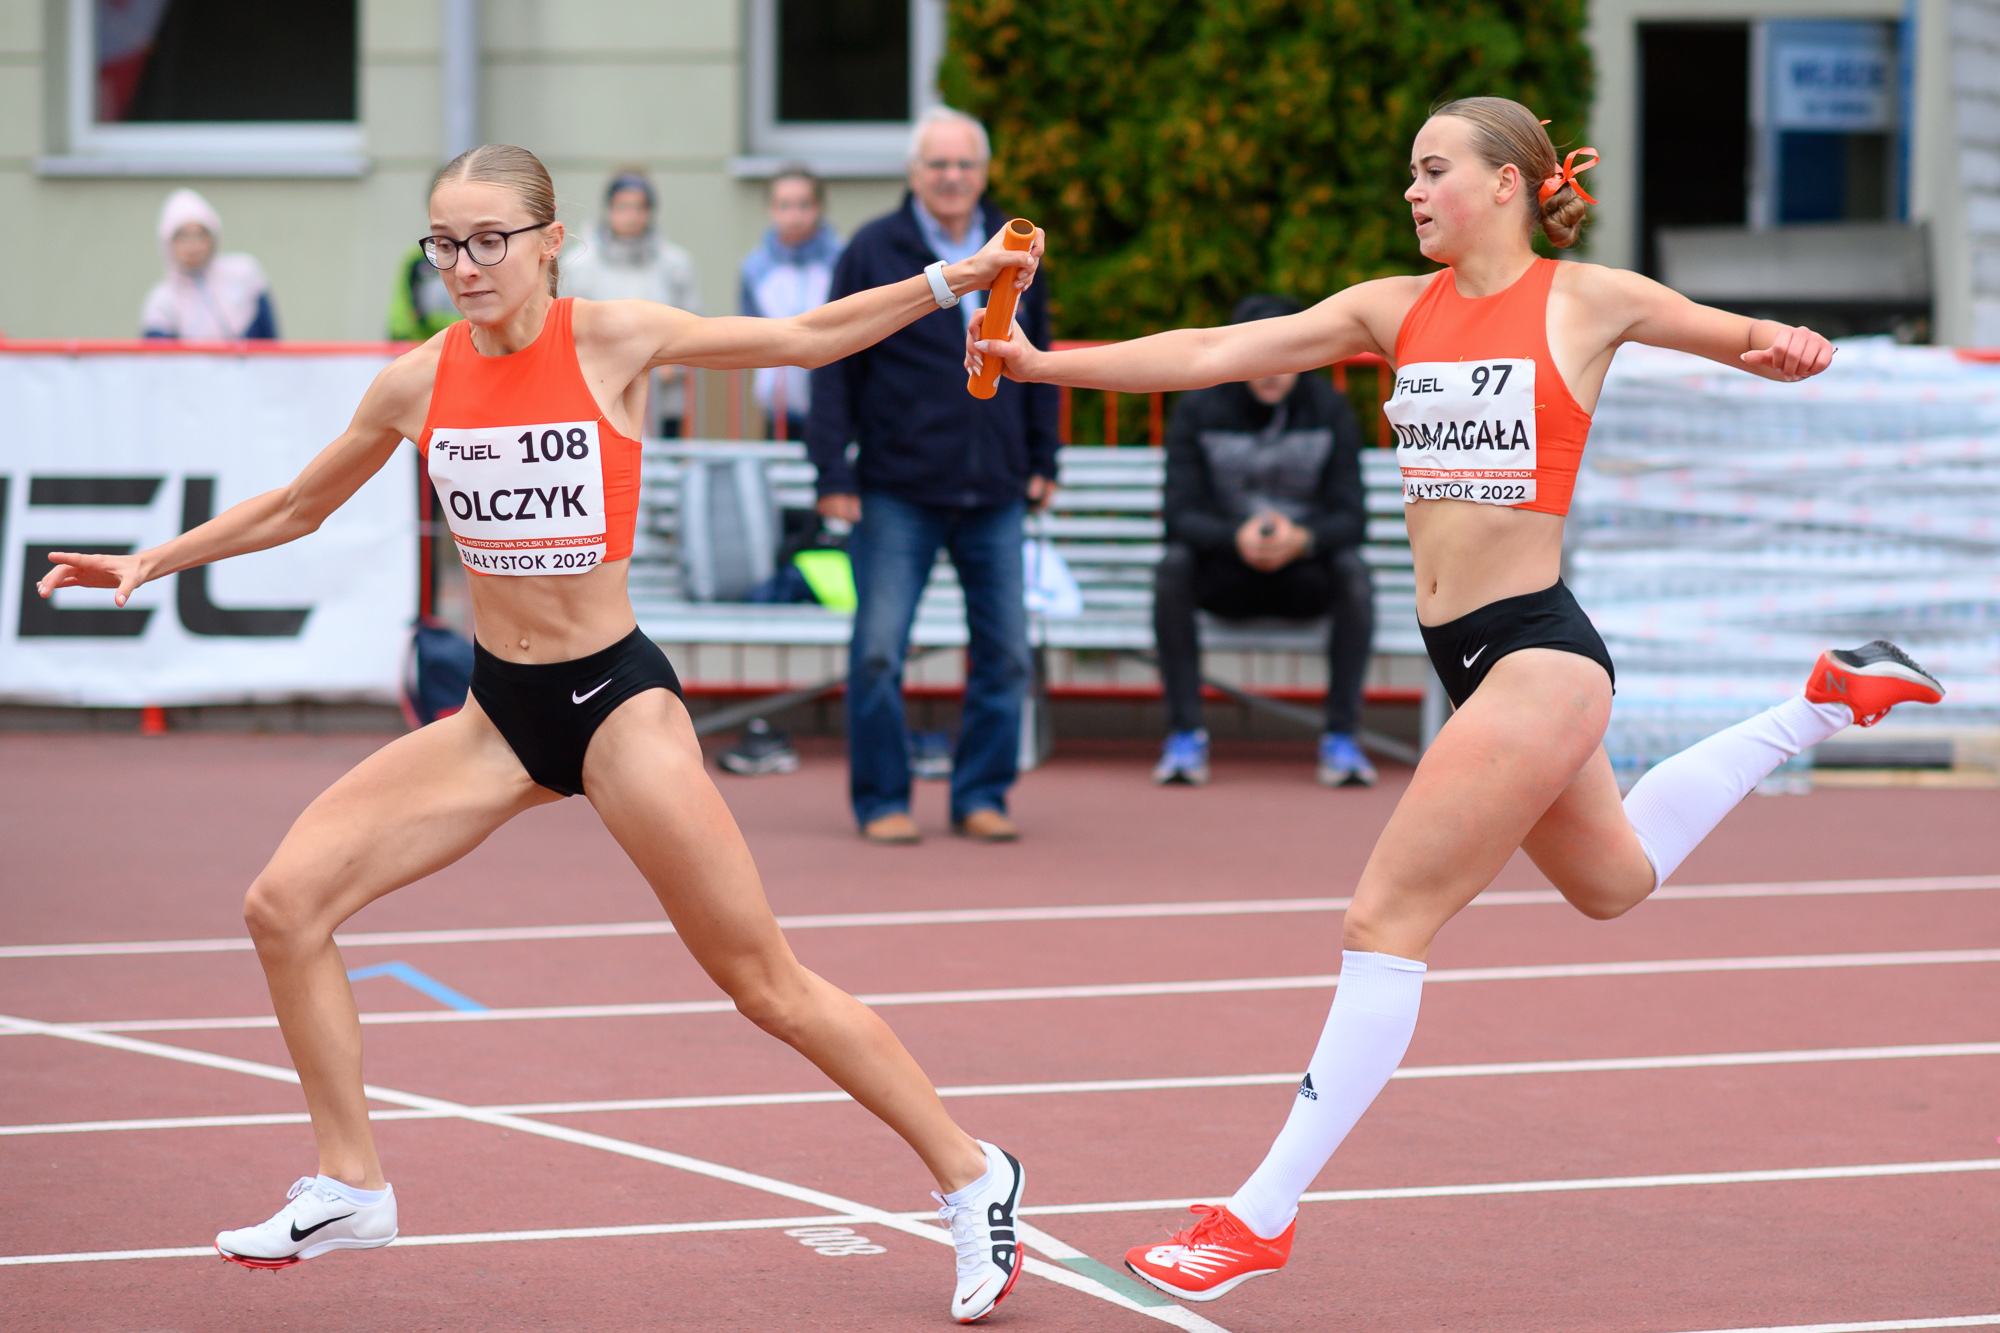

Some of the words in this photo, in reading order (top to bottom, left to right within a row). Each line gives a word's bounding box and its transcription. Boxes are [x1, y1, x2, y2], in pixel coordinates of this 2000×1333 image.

[1400, 377, 1445, 395] FUEL
[1471, 364, 1513, 396] 97
[517, 428, 589, 464] 108
[1394, 419, 1530, 451] DOMAGAŁA
[435, 440, 450, 451] 4F
[449, 444, 501, 461] FUEL
[1450, 470, 1475, 478] POLSKI
[1476, 470, 1483, 478] W
[1484, 470, 1532, 478] SZTAFETACH
[450, 484, 588, 521] OLCZYK
[1480, 485, 1526, 500] 2022
[467, 539, 516, 549] MISTRZOSTWA
[516, 540, 544, 548] POLSKI
[554, 536, 603, 546] SZTAFETACH
[0, 477, 314, 638] EL
[462, 549, 547, 570] BIAŁYSTOK
[552, 551, 597, 569] 2022
[1825, 669, 1847, 695] N
[783, 1226, 888, 1256] 800
[987, 1201, 1016, 1277] AIR
